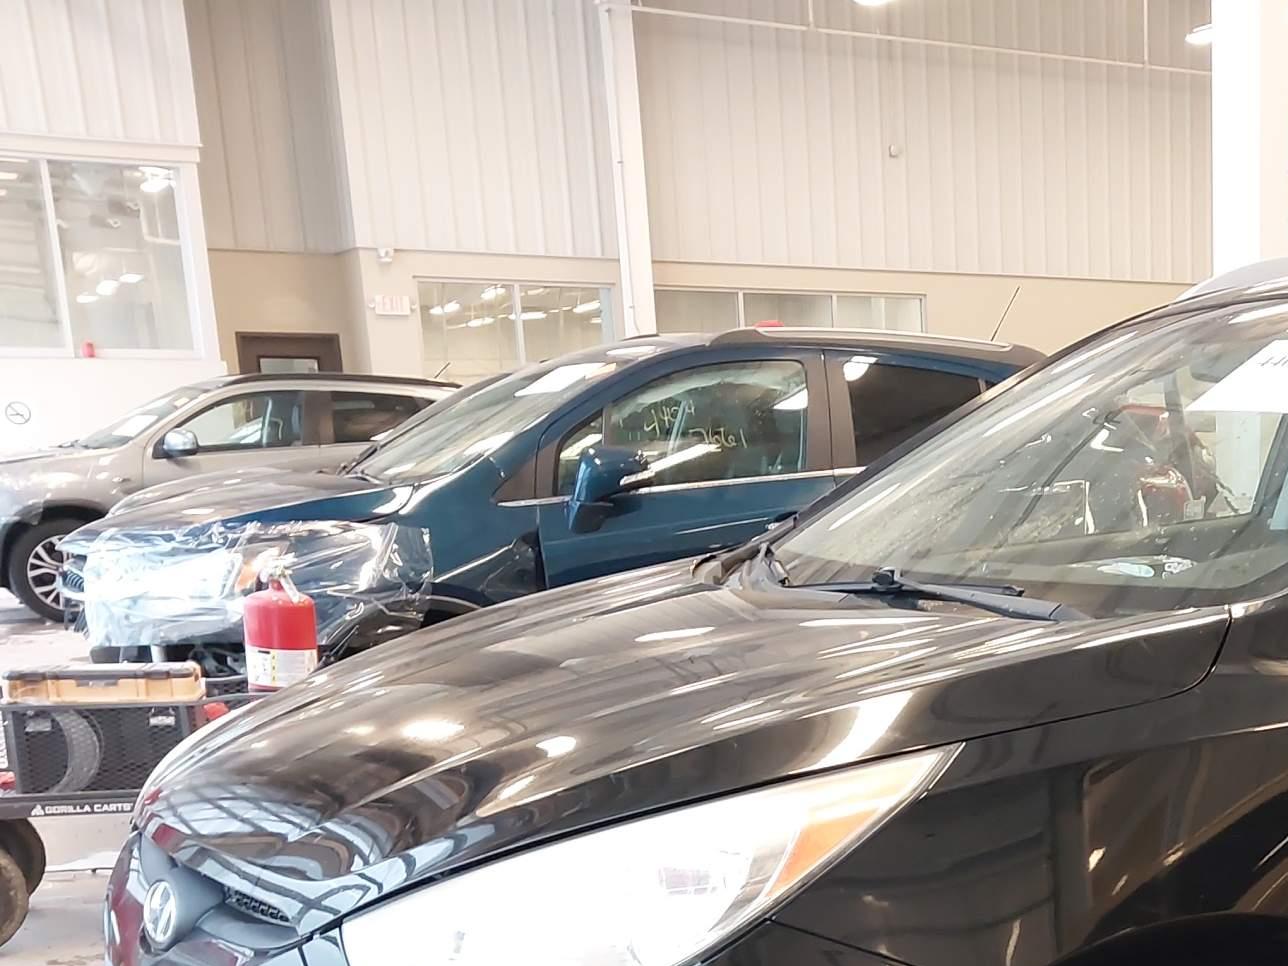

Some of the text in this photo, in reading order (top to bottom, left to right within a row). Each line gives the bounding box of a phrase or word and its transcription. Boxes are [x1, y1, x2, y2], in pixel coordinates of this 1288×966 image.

[688, 427, 748, 449] 7661
[44, 802, 131, 814] GORILLA CARTS
